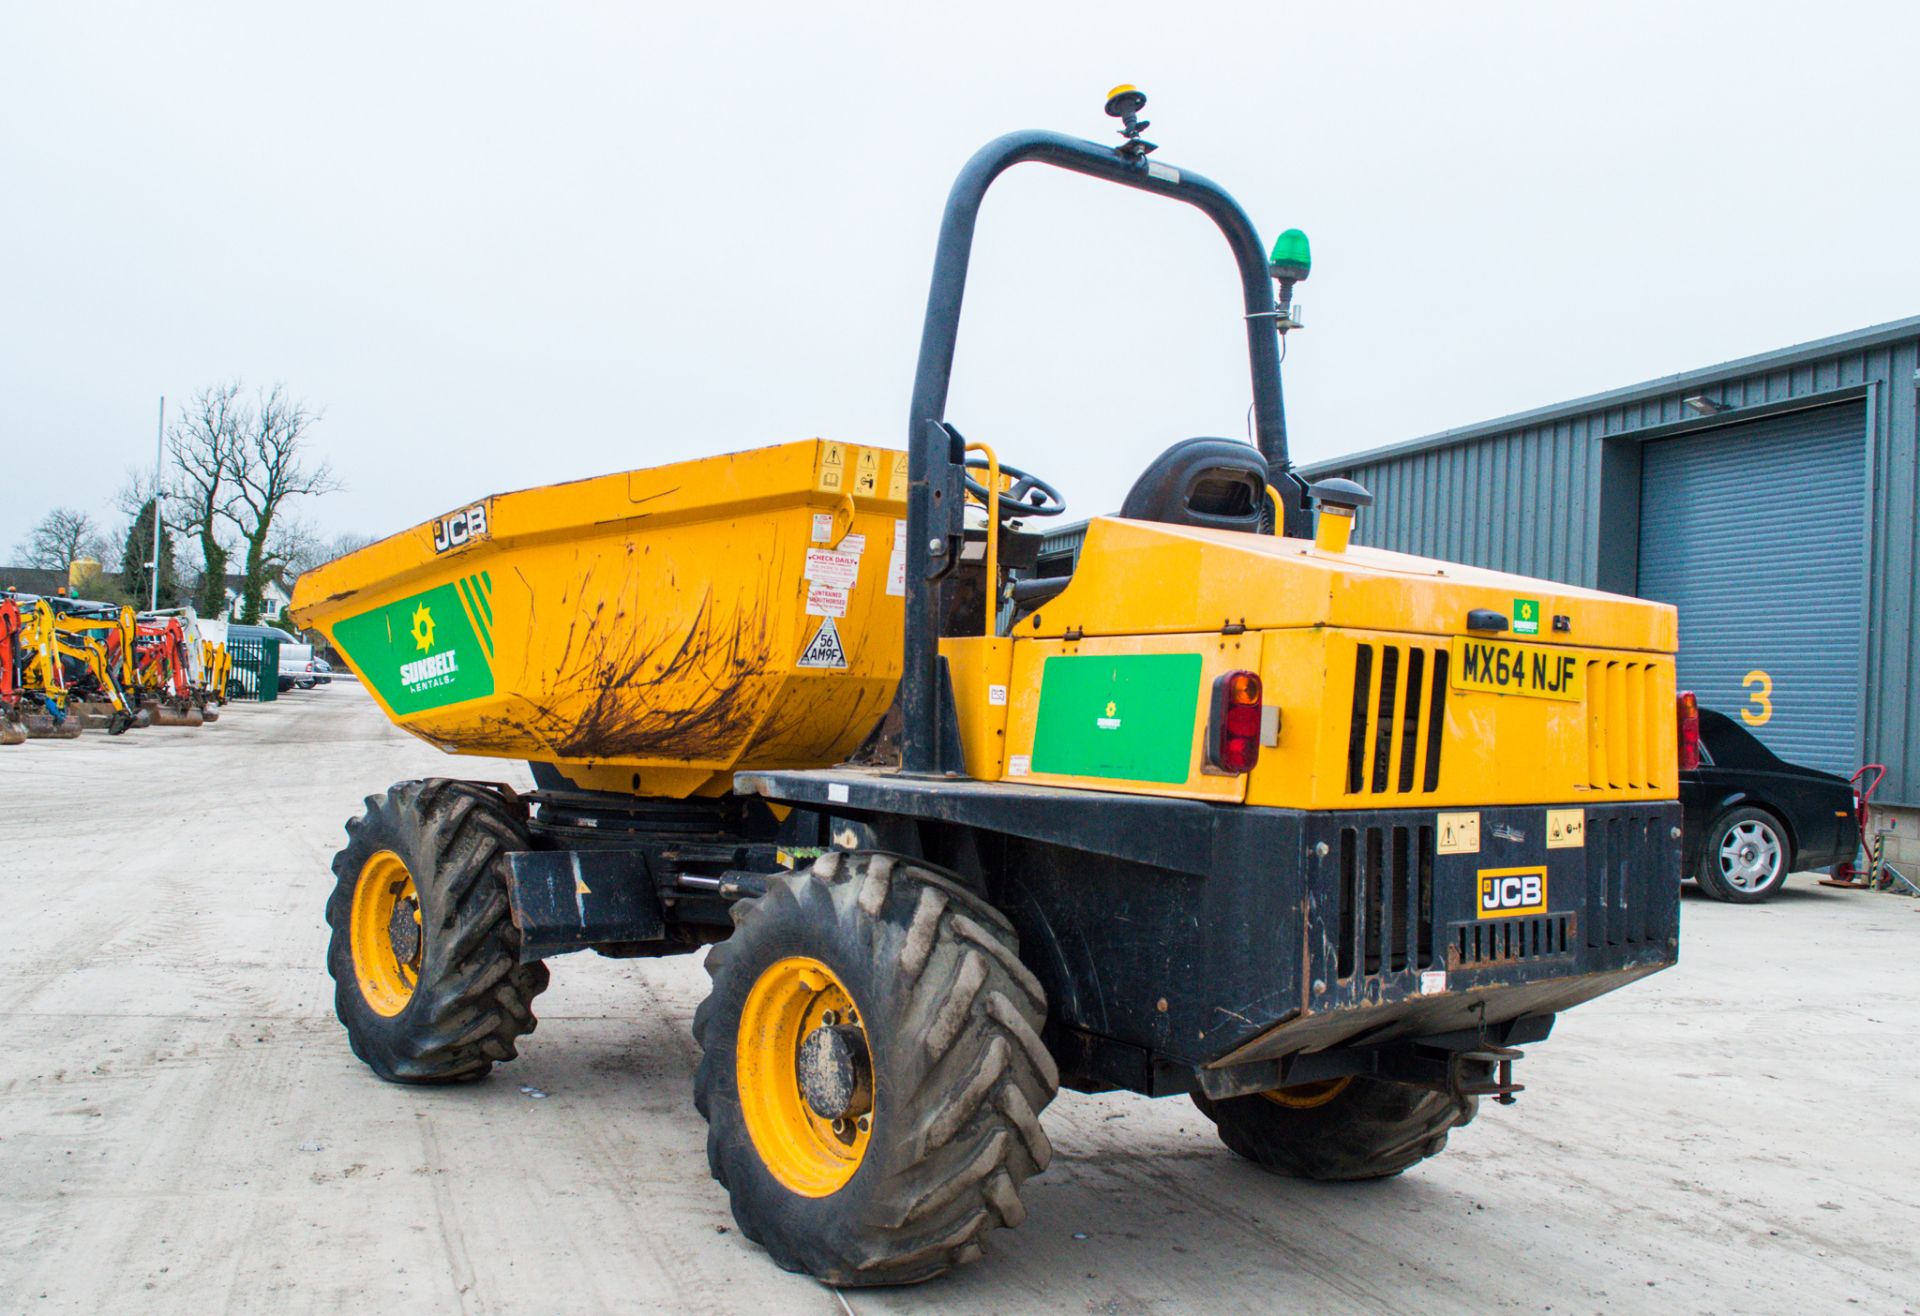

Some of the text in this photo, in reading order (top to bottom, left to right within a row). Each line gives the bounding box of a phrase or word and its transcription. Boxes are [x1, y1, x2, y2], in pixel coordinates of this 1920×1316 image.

[434, 505, 487, 551] JCB
[811, 554, 833, 562] CHECK
[834, 557, 855, 565] DAILY
[810, 648, 839, 661] AM9F
[820, 634, 833, 647] 56
[400, 649, 456, 686] SUNBELT
[1463, 643, 1576, 693] MX64 NJF
[1741, 670, 1773, 726] 3
[1483, 876, 1542, 909] JCB
